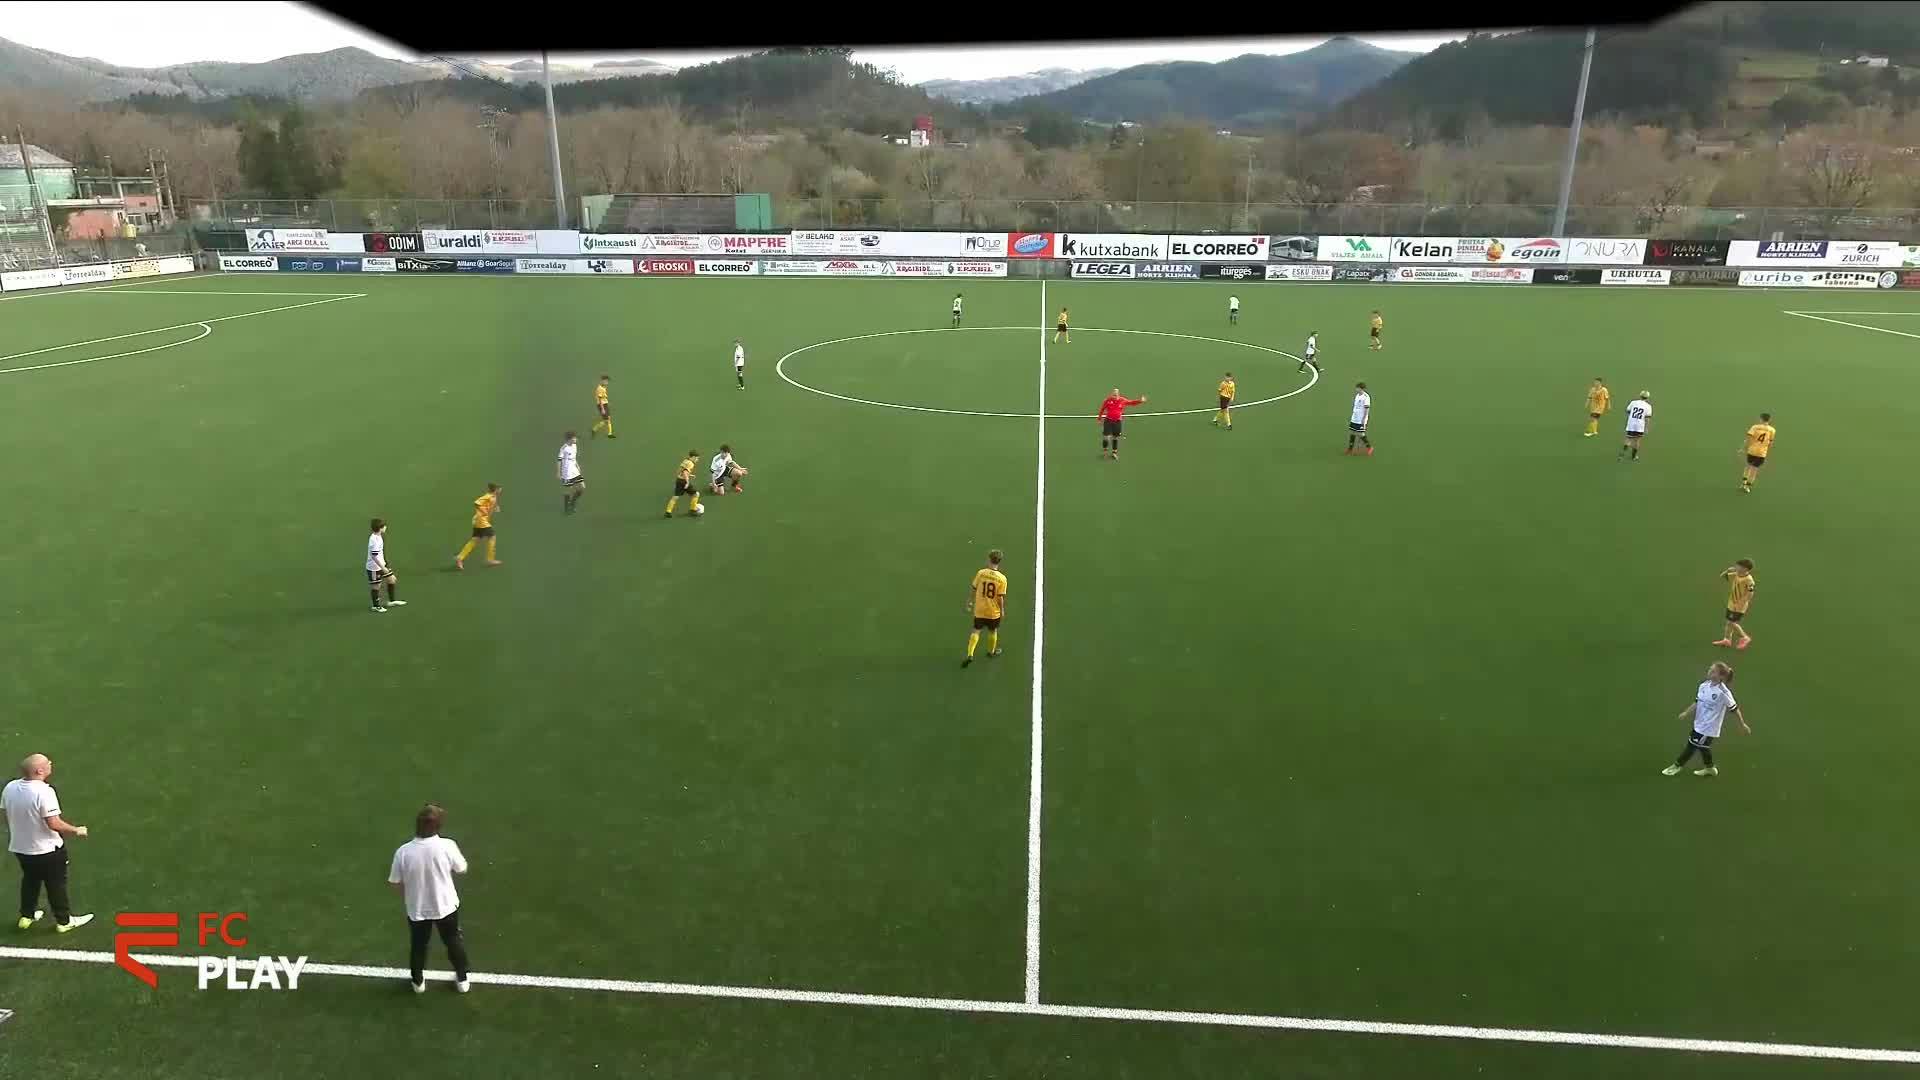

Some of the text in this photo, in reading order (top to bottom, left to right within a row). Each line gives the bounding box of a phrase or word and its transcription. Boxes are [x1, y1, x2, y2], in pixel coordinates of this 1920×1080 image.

[388, 236, 415, 250] ODIM
[439, 235, 481, 248] uraldi
[594, 238, 637, 247] Intxausti
[724, 237, 786, 248] MAPFRE
[1766, 242, 1821, 252] ARRIEN
[1080, 242, 1159, 257] kutxabank
[1172, 243, 1258, 255] EL CORREO
[1400, 241, 1453, 257] Kelan
[1511, 248, 1560, 259] egoin
[1575, 241, 1640, 257] ONURA
[1674, 245, 1717, 253] KANALA
[224, 260, 272, 268] EL CORREO
[1842, 254, 1880, 263] ZURICH
[521, 259, 567, 270] Torrealday
[652, 262, 688, 271] EROSKI
[699, 264, 750, 272] EL CORREO
[1075, 263, 1131, 274] LEGEA
[1142, 264, 1193, 272] ARRIEN
[1611, 269, 1662, 278] URRUTIA
[1753, 272, 1804, 283] uribe
[1811, 272, 1876, 283] aterpe
[1631, 406, 1644, 420] 22
[1757, 432, 1766, 444] 4
[981, 581, 996, 599] 18
